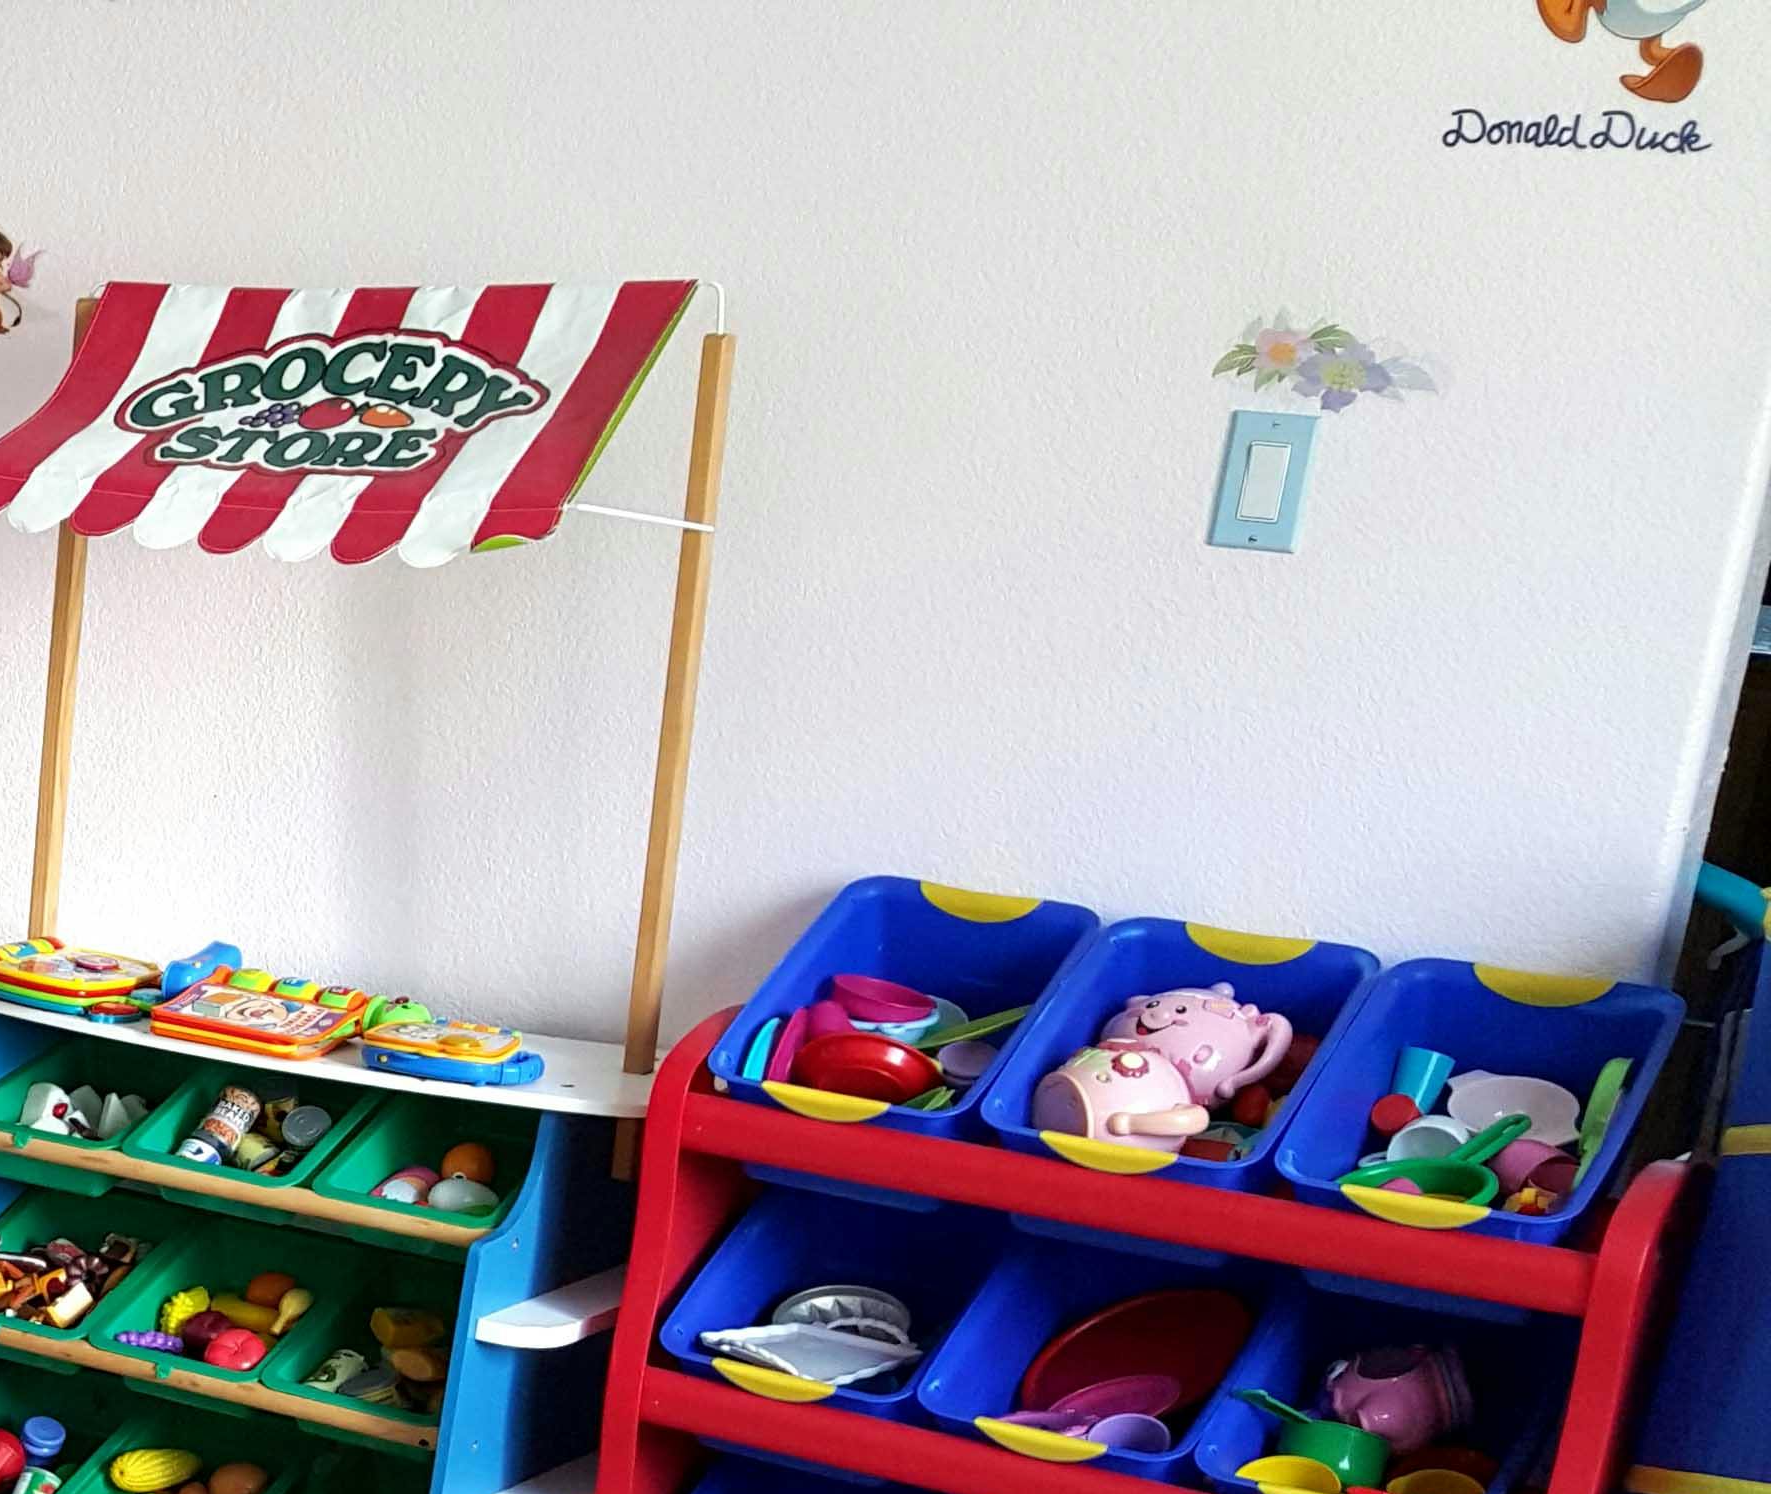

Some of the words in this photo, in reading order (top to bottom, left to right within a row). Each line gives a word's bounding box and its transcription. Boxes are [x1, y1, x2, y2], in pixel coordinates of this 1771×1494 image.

[1442, 108, 1587, 149] Donald
[1589, 109, 1712, 154] Duck
[130, 341, 533, 428] GROCERY
[159, 425, 438, 468] STORE
[218, 1100, 250, 1122] BAKED
